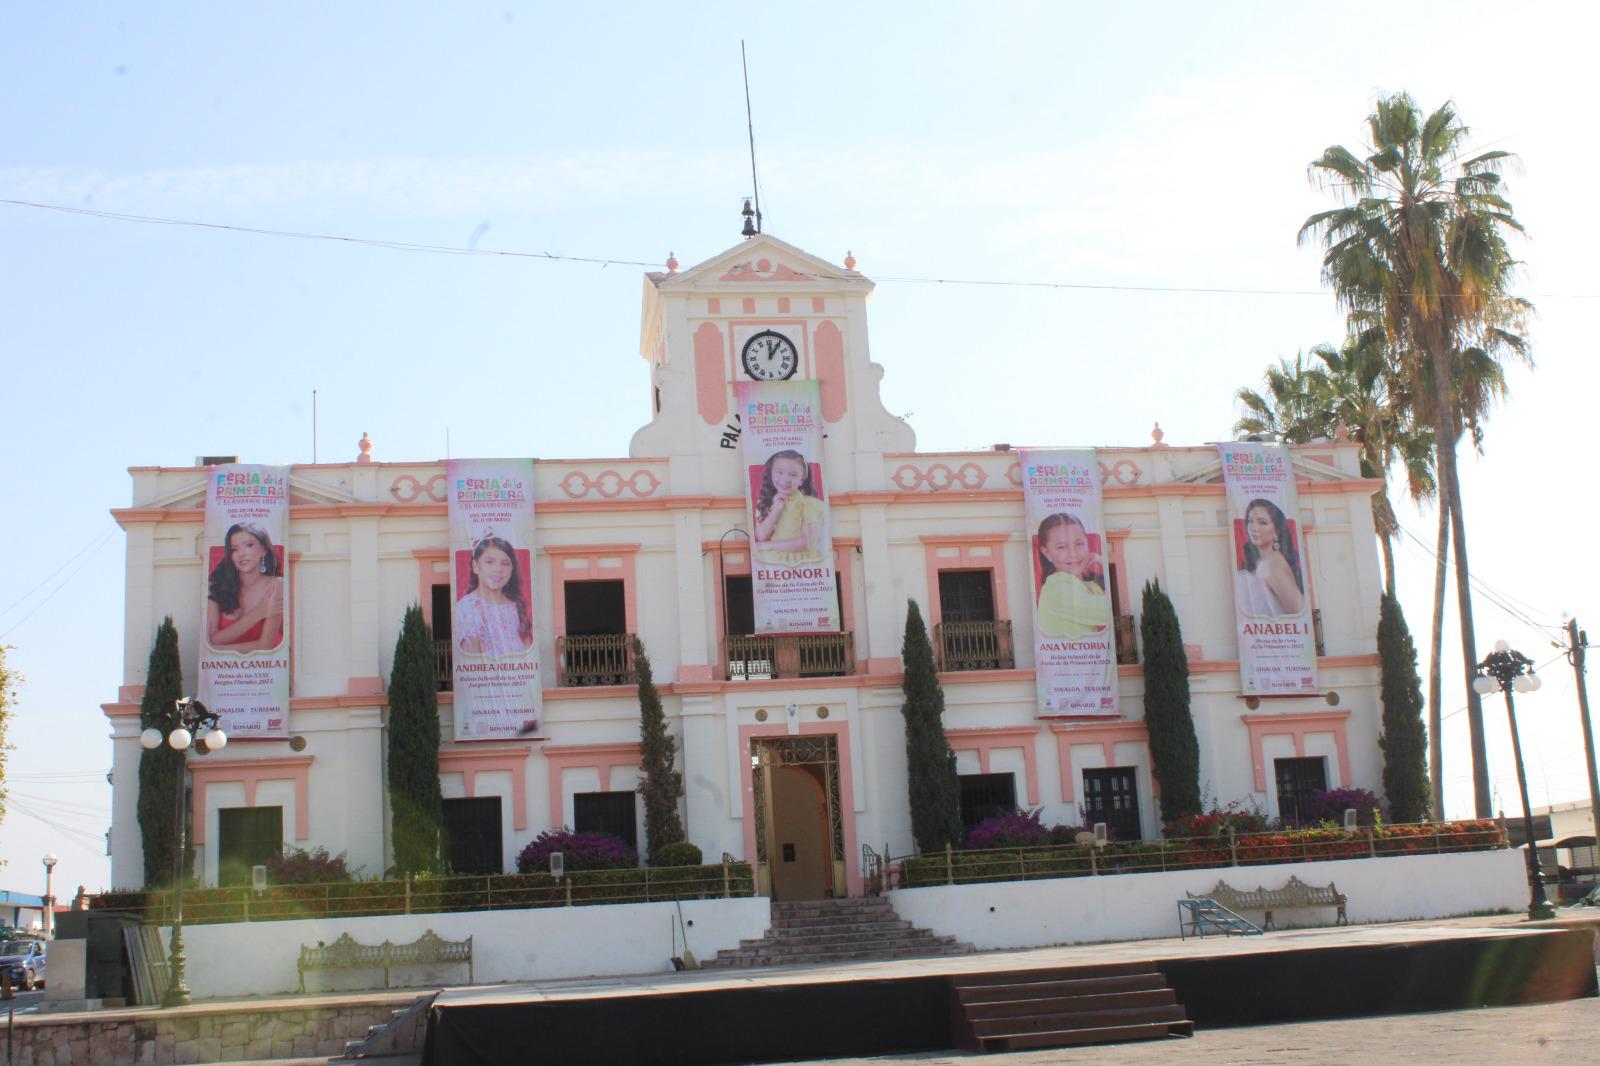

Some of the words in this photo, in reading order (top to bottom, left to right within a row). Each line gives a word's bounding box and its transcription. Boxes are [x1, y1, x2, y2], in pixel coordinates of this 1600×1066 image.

[758, 568, 822, 580] ELEONOR
[826, 568, 830, 578] I
[1243, 624, 1301, 635] ANABEL
[1304, 623, 1308, 634] I
[1062, 642, 1106, 650] VICTORIA
[201, 661, 239, 670] DANNA
[241, 660, 281, 669] CAMILA
[456, 664, 496, 672] ANDREA
[497, 662, 534, 671] KEILANI
